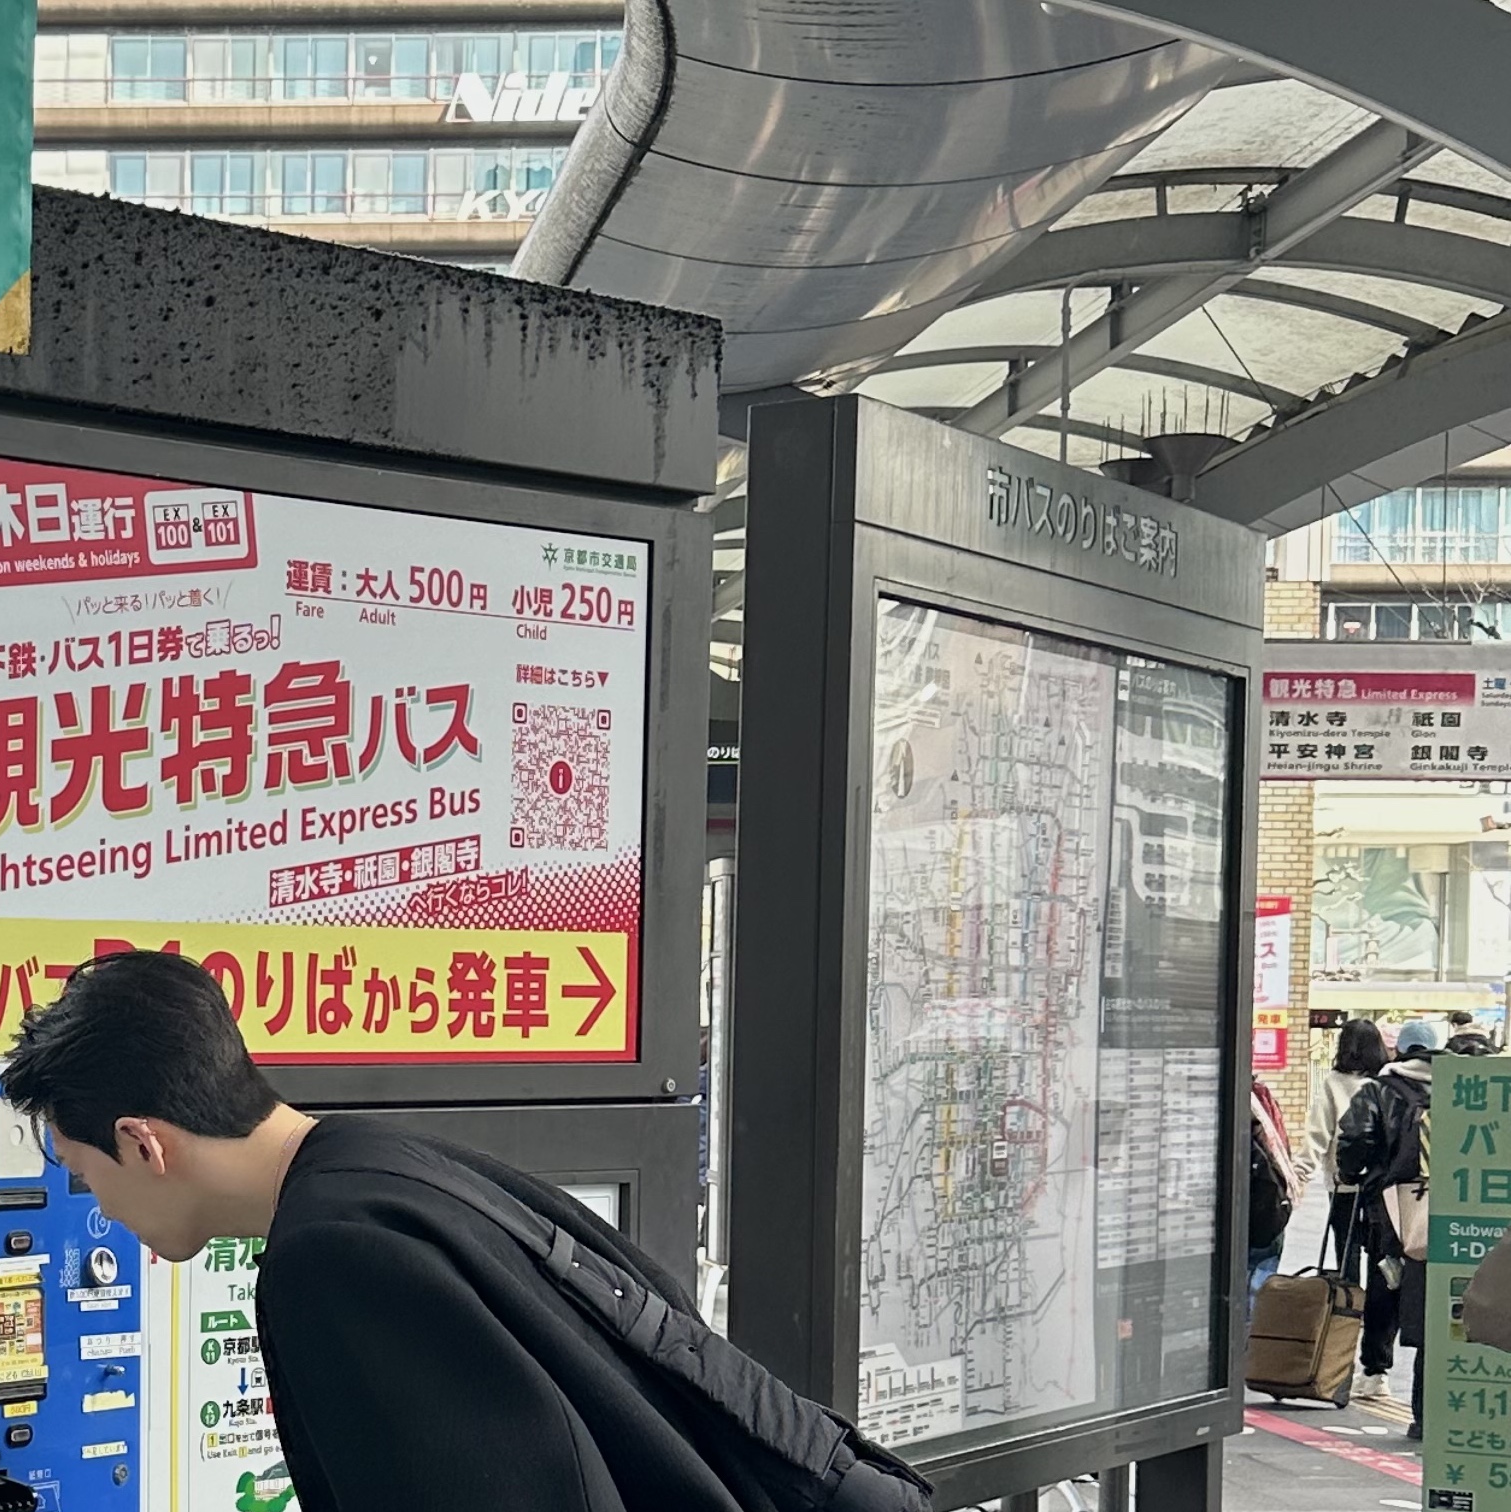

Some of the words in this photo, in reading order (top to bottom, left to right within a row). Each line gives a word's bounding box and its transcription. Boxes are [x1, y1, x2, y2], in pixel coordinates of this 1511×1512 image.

[445, 72, 600, 122] Nide
[162, 507, 182, 521] EX
[211, 503, 230, 518] EX
[987, 466, 1179, 578] 市バスのりばご案内
[157, 525, 189, 547] 100
[207, 522, 236, 544] 101
[14, 554, 75, 573] weekends
[90, 550, 140, 570] holidays
[564, 547, 637, 572] 京都市交通局
[295, 600, 325, 618] Fare
[358, 607, 396, 626] Adult
[516, 623, 547, 641] Child
[515, 664, 596, 688] 詳細はこちら
[1270, 678, 1357, 699] 観光特急
[1361, 688, 1407, 700] Limited
[1410, 688, 1458, 701] Express
[1269, 710, 1347, 727] 清水寺
[1411, 711, 1461, 728] 祇園
[1268, 743, 1375, 760] 平安神宮
[165, 808, 287, 864] Limited
[301, 795, 418, 845] Express
[429, 785, 481, 821] Bus
[270, 838, 481, 905] 清水寺・祇園・銀閣寺
[207, 1314, 239, 1329] ルート
[1447, 1355, 1491, 1375] 大人
[223, 1398, 264, 1419] 九条駅
[1447, 1430, 1505, 1451] こども
